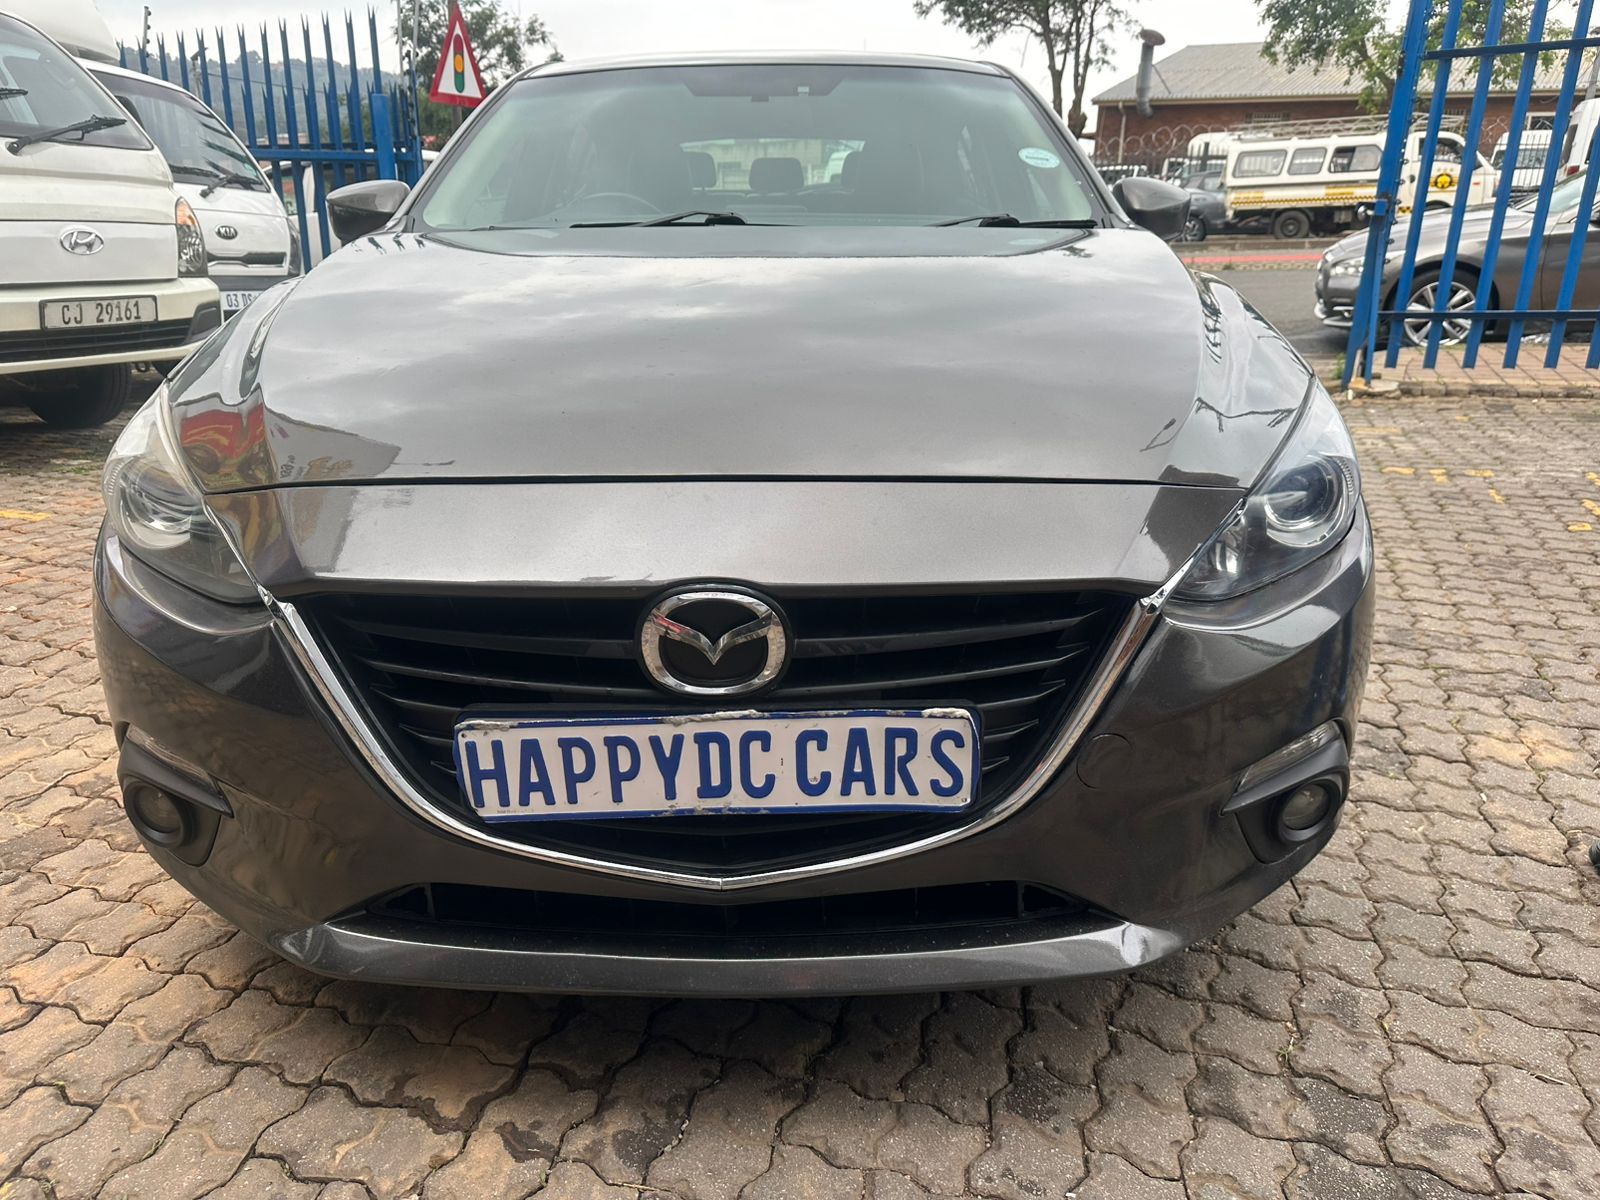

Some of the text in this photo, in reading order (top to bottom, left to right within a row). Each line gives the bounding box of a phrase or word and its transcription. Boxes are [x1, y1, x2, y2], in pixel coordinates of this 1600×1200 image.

[219, 226, 236, 237] KIA
[226, 293, 239, 308] 03
[61, 300, 141, 326] CJ 29161
[464, 726, 965, 808] HAPPYDC CARS
